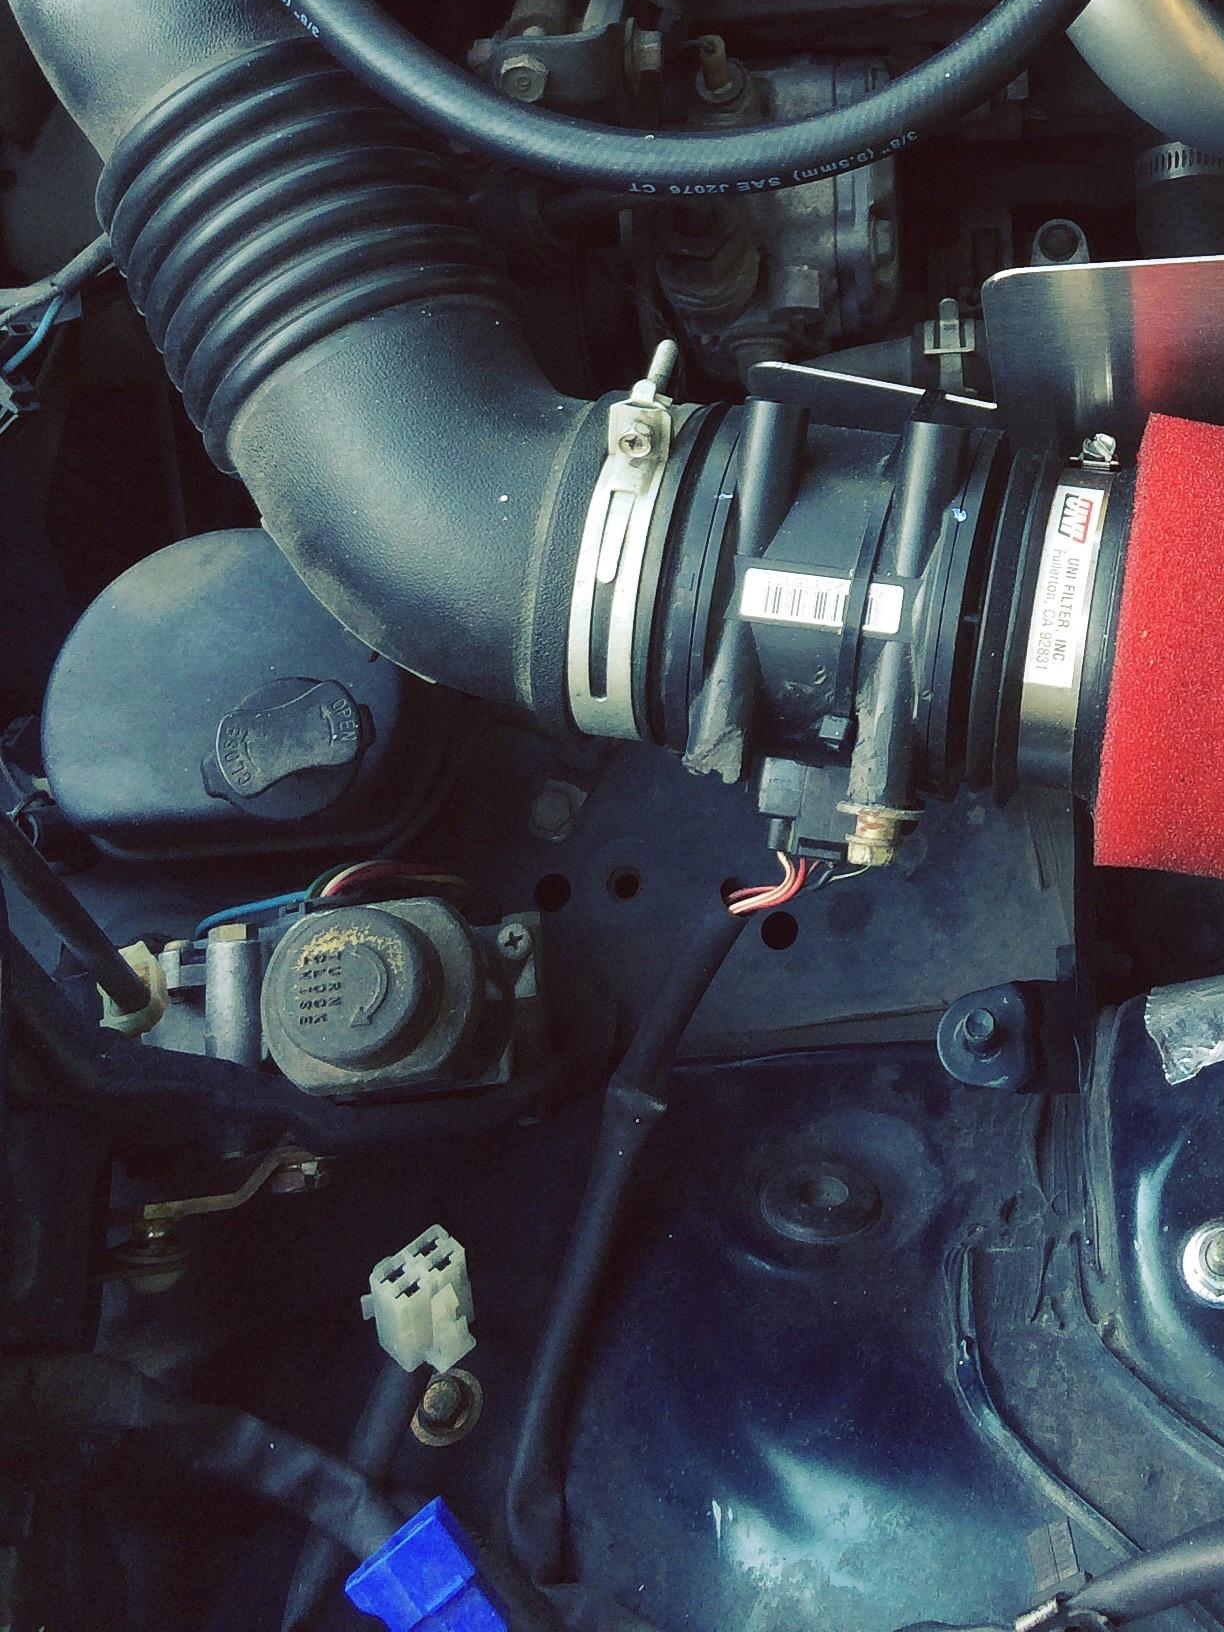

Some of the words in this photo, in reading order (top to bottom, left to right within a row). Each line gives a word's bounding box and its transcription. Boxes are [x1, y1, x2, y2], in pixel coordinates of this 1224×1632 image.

[793, 148, 876, 182] (9.5mm)
[629, 182, 657, 194] CT
[670, 183, 729, 195] J2076
[736, 176, 782, 193] SAE
[1057, 492, 1094, 544] UNI
[1043, 548, 1066, 604] Fullerton,
[1066, 558, 1080, 580] UNI
[1042, 611, 1055, 627] CA
[1035, 631, 1053, 670] 92831
[330, 698, 358, 742] OPEN
[223, 727, 251, 786] CLOSE
